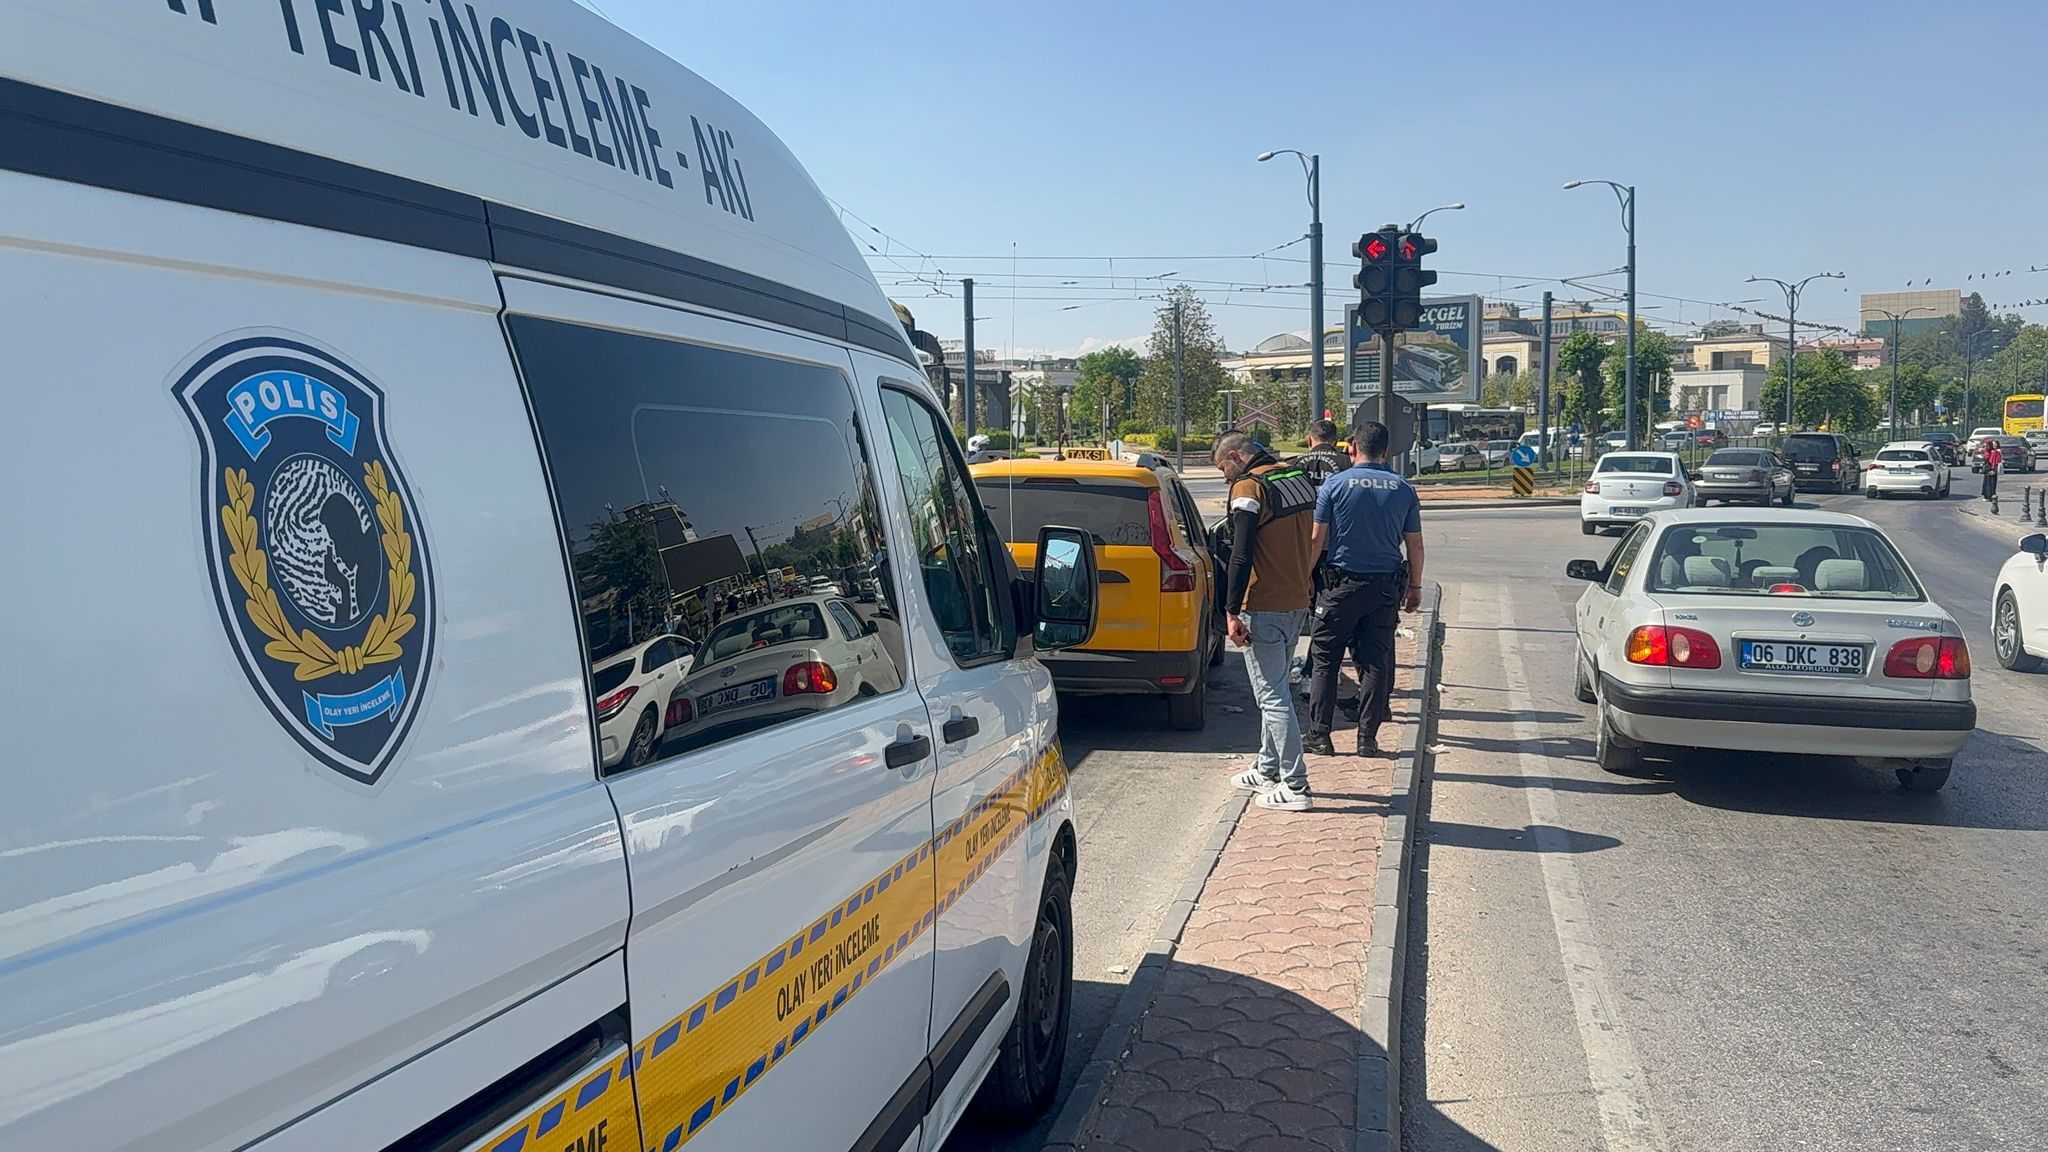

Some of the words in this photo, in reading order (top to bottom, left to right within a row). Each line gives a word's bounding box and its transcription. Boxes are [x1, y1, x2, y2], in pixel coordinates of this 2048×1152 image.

[234, 377, 338, 425] POLİS
[1753, 644, 1774, 662] 06
[1786, 645, 1818, 665] DKC
[1829, 647, 1861, 667] 838
[1795, 664, 1840, 673] KORUSUN
[324, 707, 343, 717] OLAY
[343, 704, 360, 716] YERİ
[360, 690, 392, 712] İNCELEME
[965, 830, 979, 862] OLAY
[777, 969, 807, 1022] OLAY
[810, 949, 833, 995] YERİ
[835, 913, 880, 976] İNCELEME
